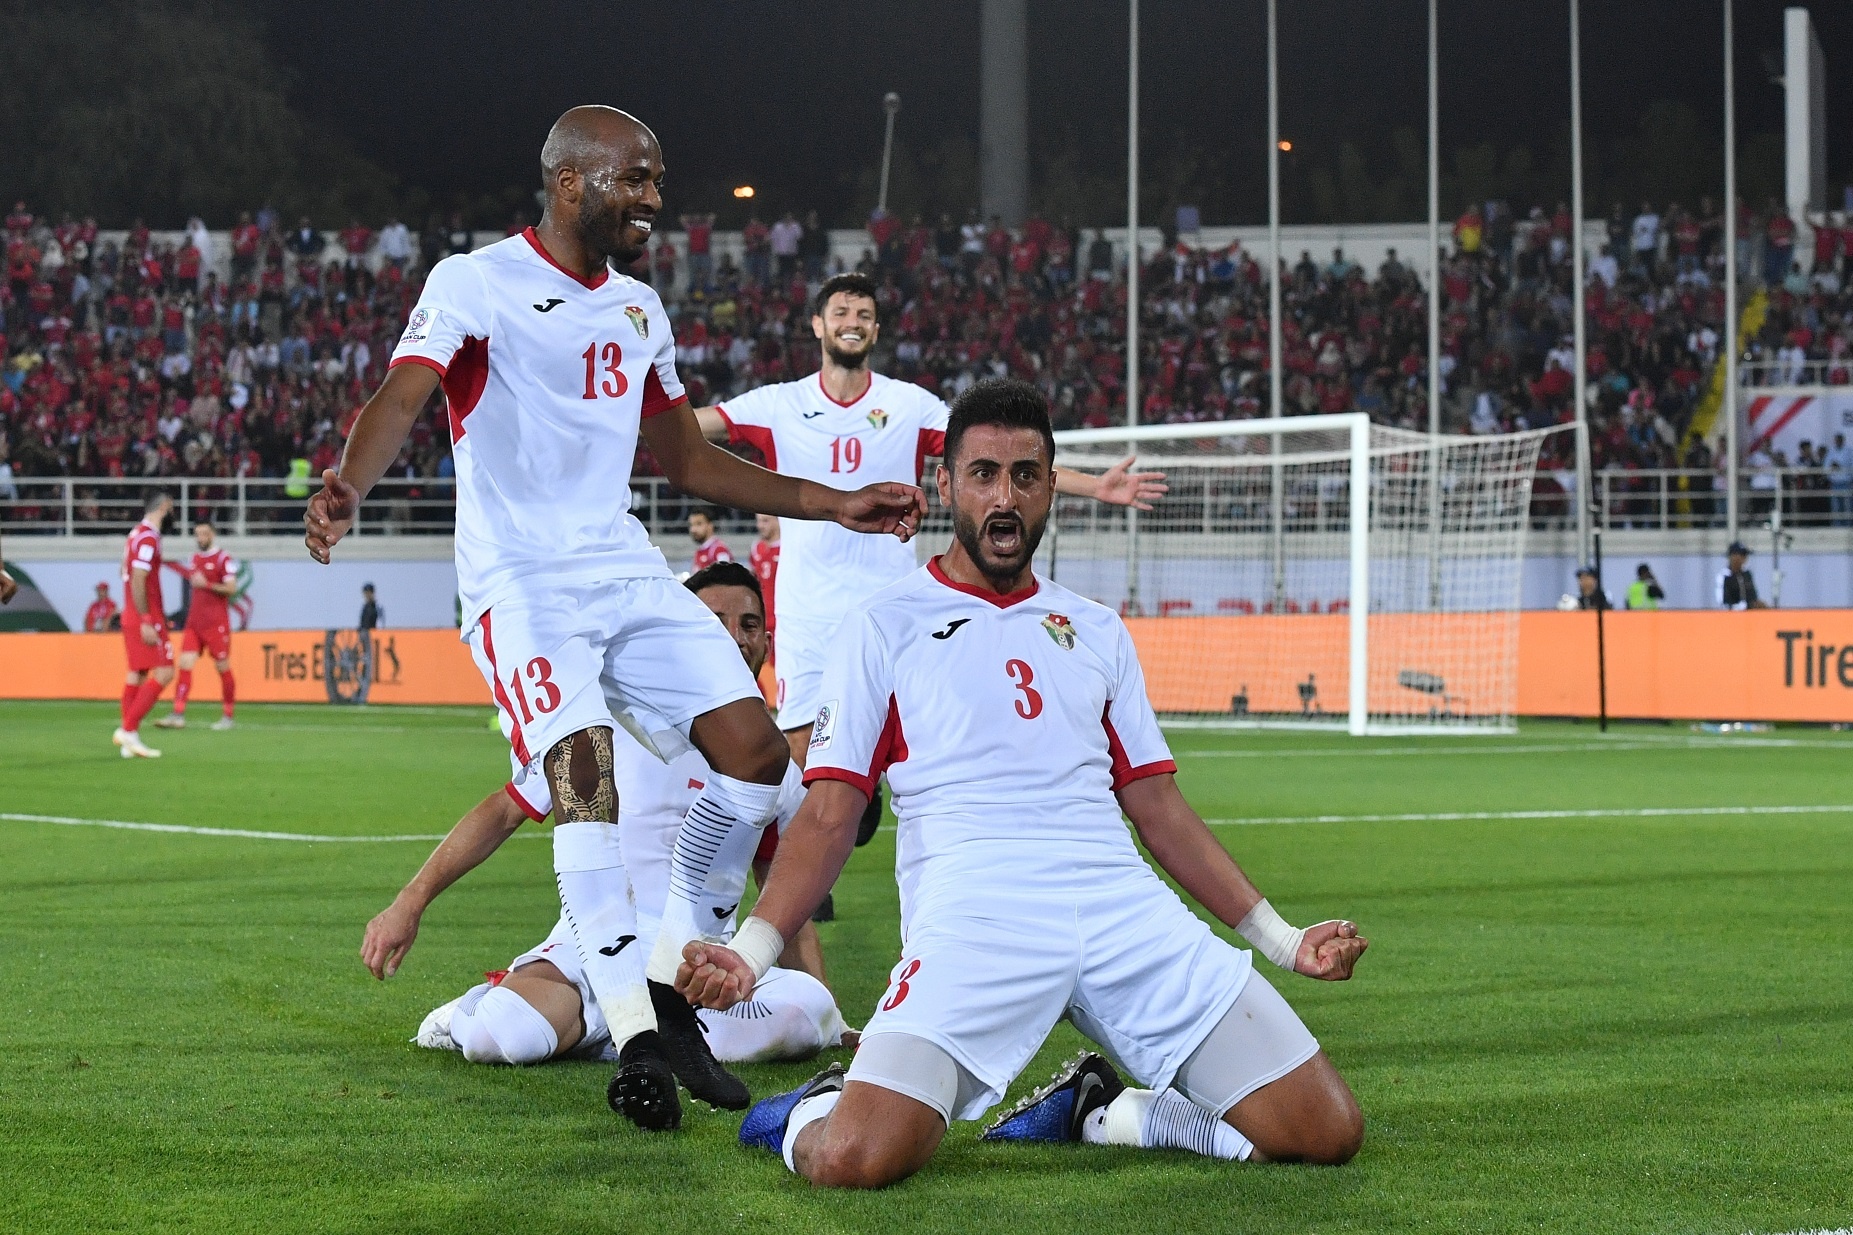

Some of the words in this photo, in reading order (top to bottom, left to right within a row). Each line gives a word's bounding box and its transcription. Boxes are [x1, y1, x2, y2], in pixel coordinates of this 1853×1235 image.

[582, 342, 629, 400] 13
[830, 436, 862, 474] 19
[261, 643, 307, 680] Tires
[1005, 658, 1043, 720] 3
[510, 656, 562, 726] 13
[882, 959, 921, 1012] 3
